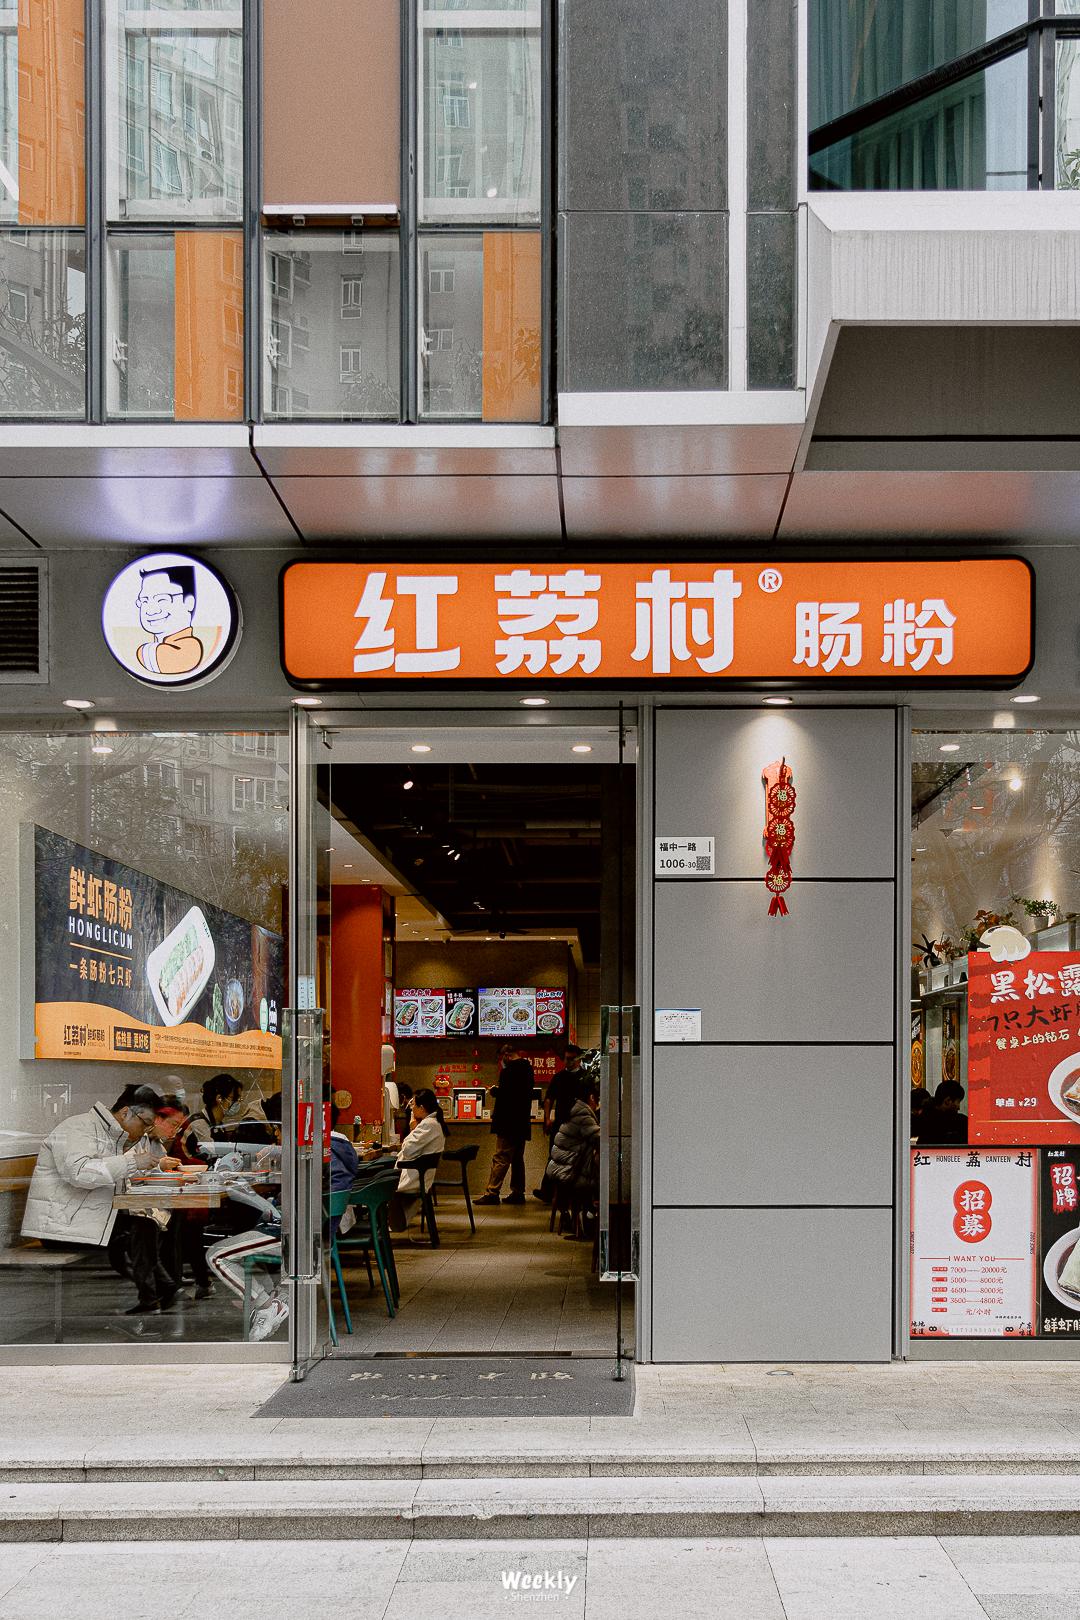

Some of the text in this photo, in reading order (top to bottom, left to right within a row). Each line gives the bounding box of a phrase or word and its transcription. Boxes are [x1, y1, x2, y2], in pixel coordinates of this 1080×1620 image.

[353, 569, 743, 675] 红荔村
[792, 599, 957, 673] 肠粉
[659, 842, 697, 852] 福中一路
[69, 865, 133, 931] 鲜虾肠粉
[68, 916, 133, 950] HONGLICUN
[69, 957, 133, 989] 一条肠粉七只虾
[996, 1028, 1070, 1051] 餐桌上的钻石
[995, 1098, 1015, 1107] 单点
[913, 1151, 931, 1167] 红
[965, 1151, 981, 1167] 荔
[985, 1155, 1011, 1163] CANTEEN
[1015, 1151, 1033, 1168] 村
[1052, 1166, 1077, 1207] 招牌
[960, 1189, 986, 1237] 招募
